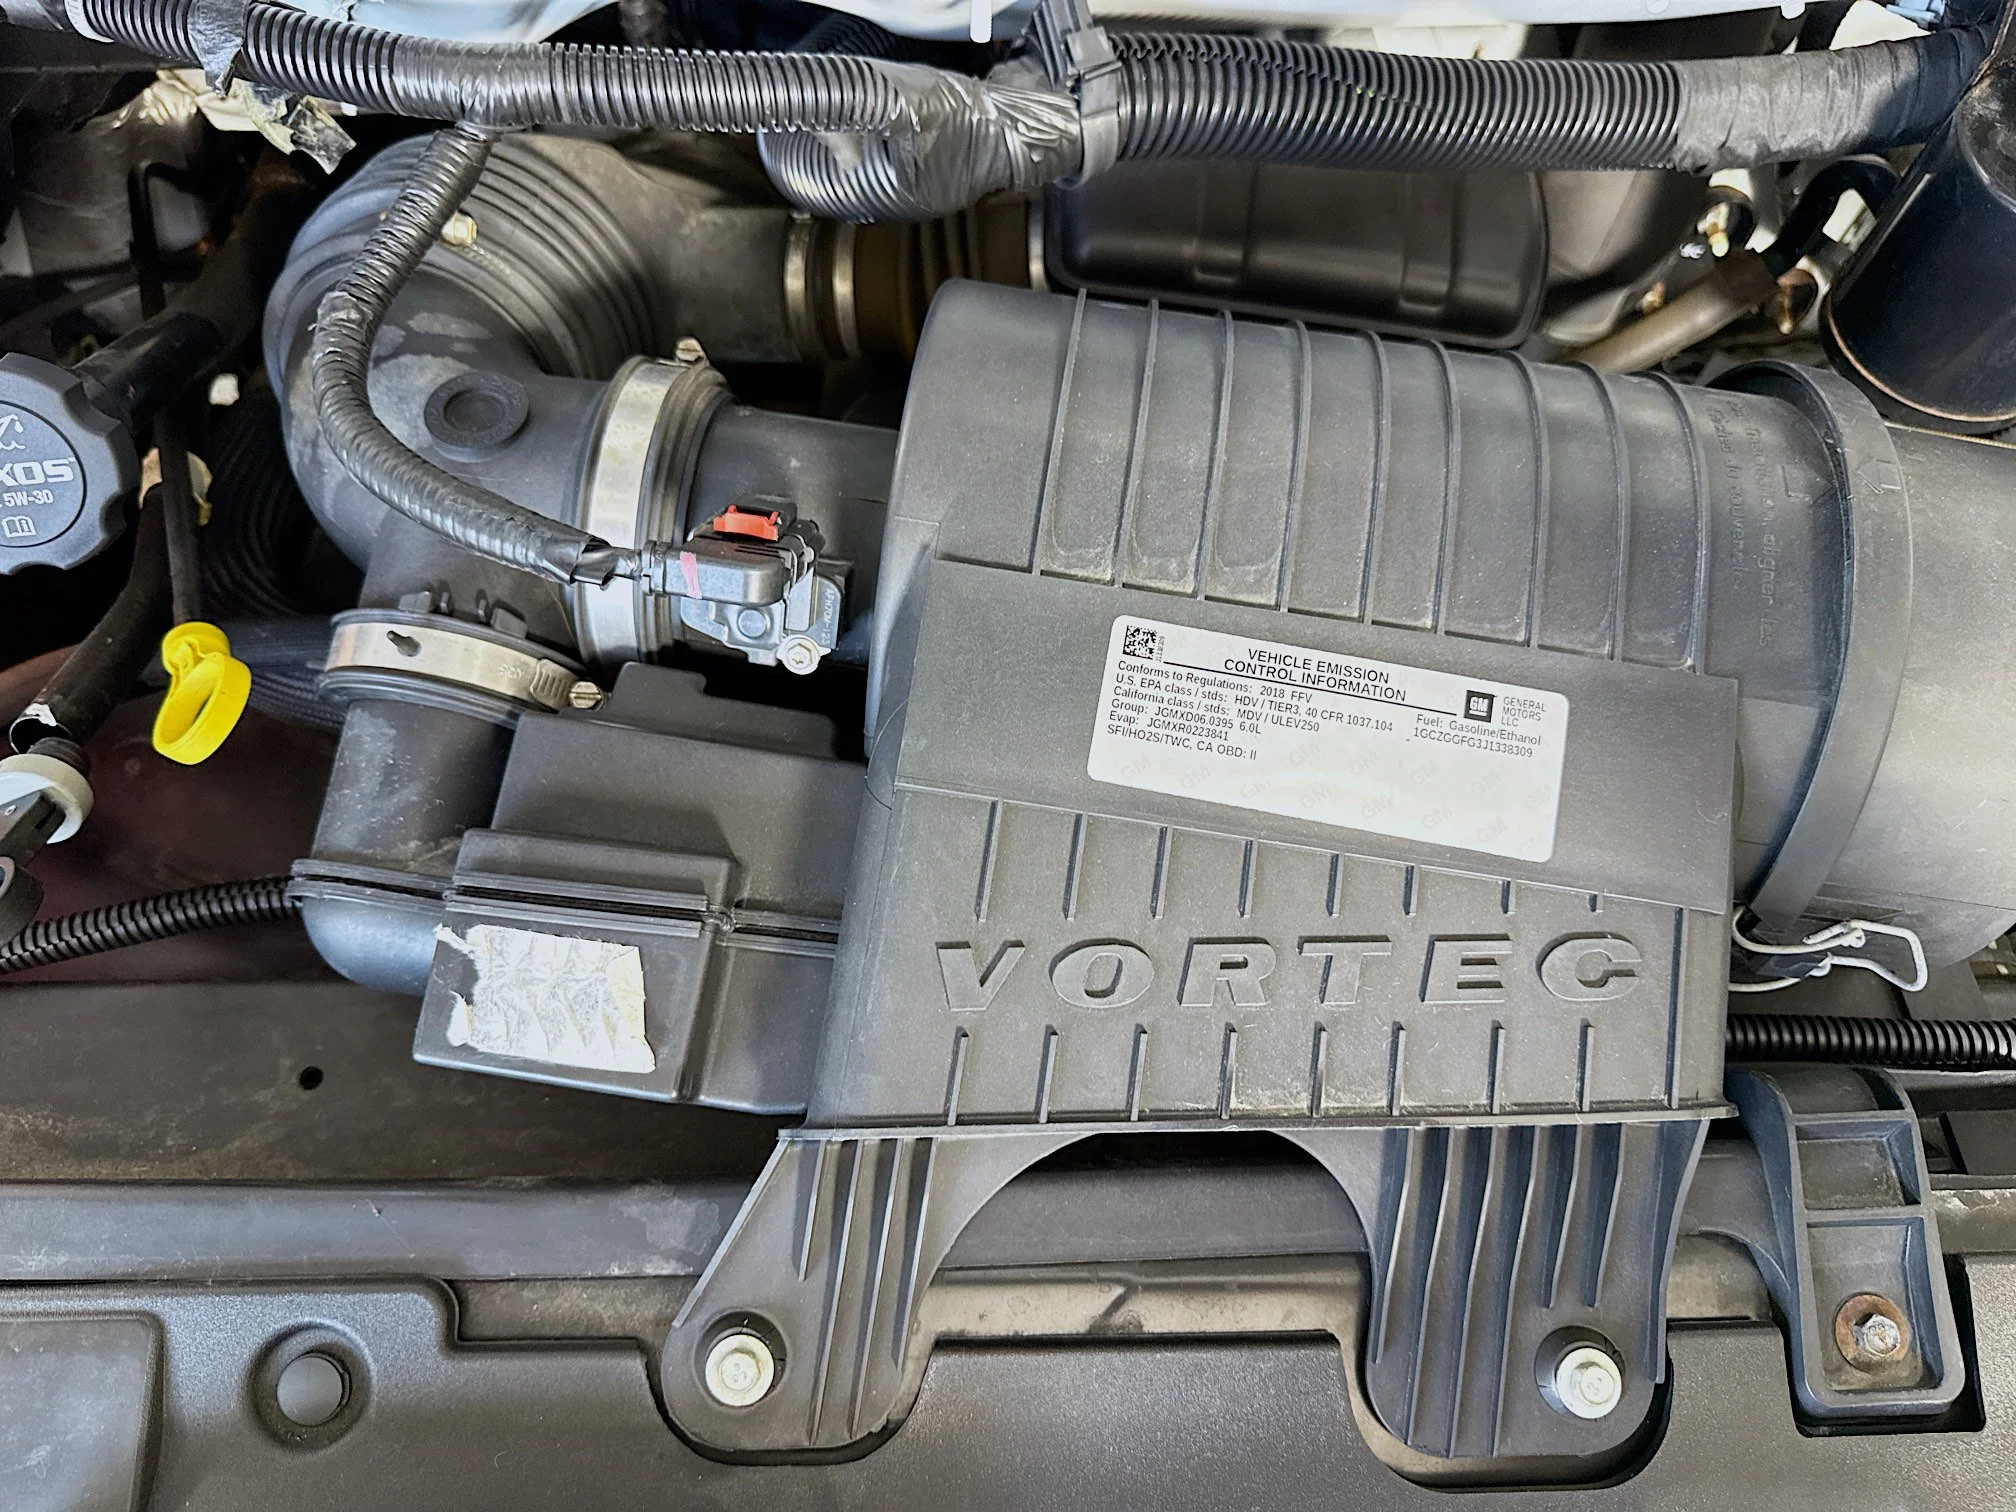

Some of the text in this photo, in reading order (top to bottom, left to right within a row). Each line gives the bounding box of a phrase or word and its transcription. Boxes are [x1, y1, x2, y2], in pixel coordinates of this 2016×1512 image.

[1724, 458, 1743, 480] du
[3, 489, 54, 507] 5W-30
[1760, 617, 1780, 646] les
[1118, 660, 1313, 703] Conforms to Regulations: 2018 FFV
[1224, 658, 1406, 701] CONTROL INFORMATION
[1248, 648, 1389, 684] VEHICLE EMISSION
[1111, 698, 1261, 734] Group: JGMXD06.0395 6.0L
[1113, 685, 1320, 732] California class / stds: MDV / ULEV250
[1116, 673, 1392, 732] U.S. EPA class / stds: HDV / TIER3, 40 CFR 1037.104
[1469, 696, 1489, 714] GM
[1502, 706, 1541, 721] MOTORS
[1503, 696, 1546, 712] GENERAL
[1109, 710, 1228, 741] Evap: JGMXR0223841
[1416, 713, 1541, 746] Fuel: Gasoline/Ethanol
[1501, 716, 1518, 727] LLC
[1107, 723, 1257, 760] SFI/HO2S/TWC, CA OBD: II
[1413, 727, 1533, 758] 1GCZGGFG3J1338309
[934, 931, 1644, 1013] VORTEC
